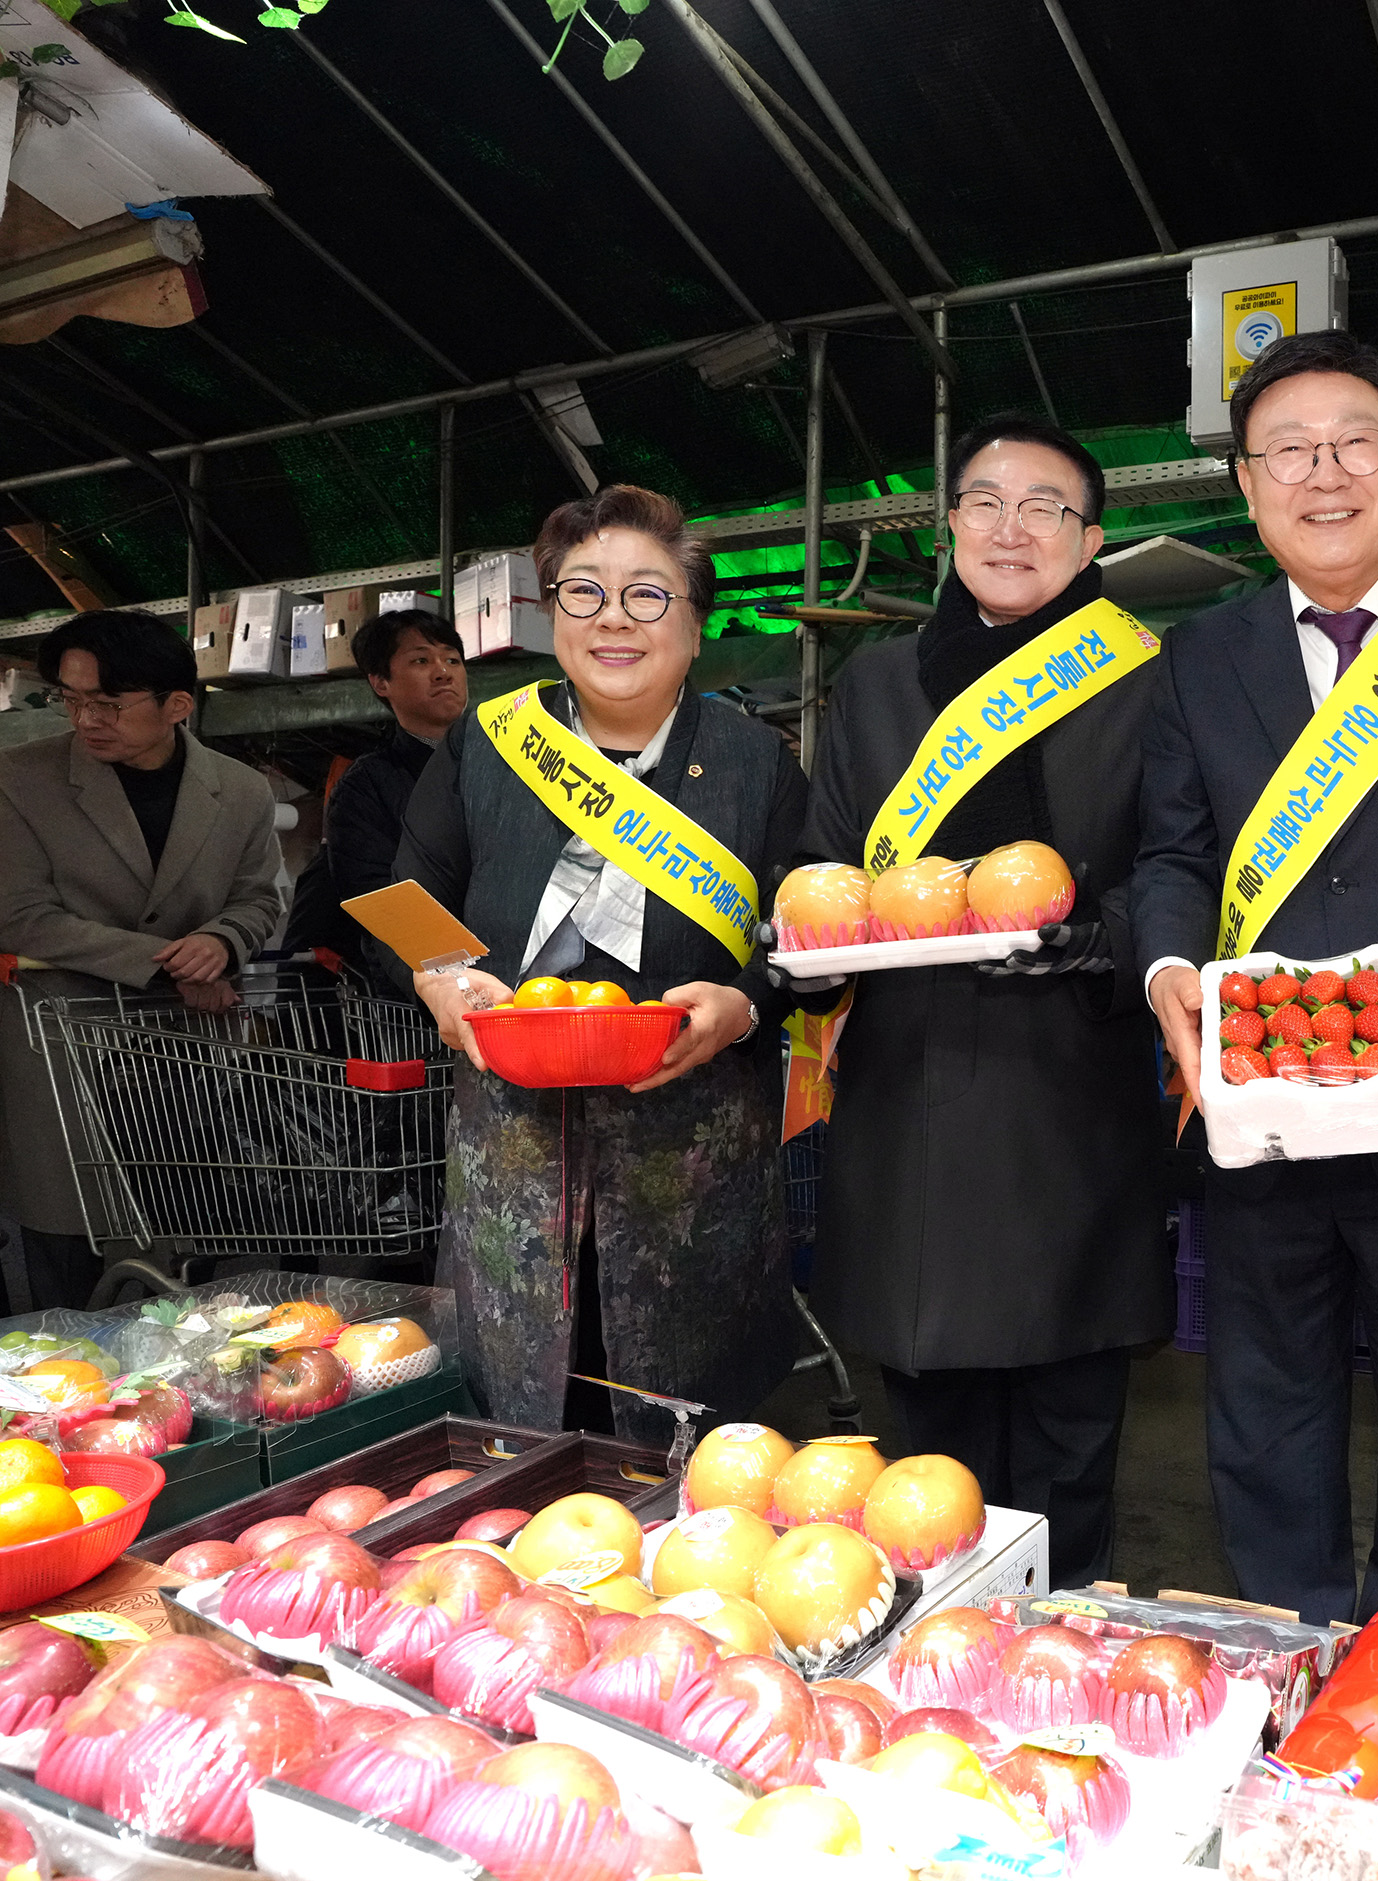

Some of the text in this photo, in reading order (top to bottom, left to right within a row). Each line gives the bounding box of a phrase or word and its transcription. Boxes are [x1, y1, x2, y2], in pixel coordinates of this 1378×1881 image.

[1234, 298, 1284, 311] 무료로 이용하세요!
[1242, 291, 1276, 302] 공공와이파이
[981, 629, 1116, 732] 전통시장
[520, 724, 615, 818] 전통시장
[899, 726, 983, 838] 장보기
[1219, 901, 1245, 961] 애용
